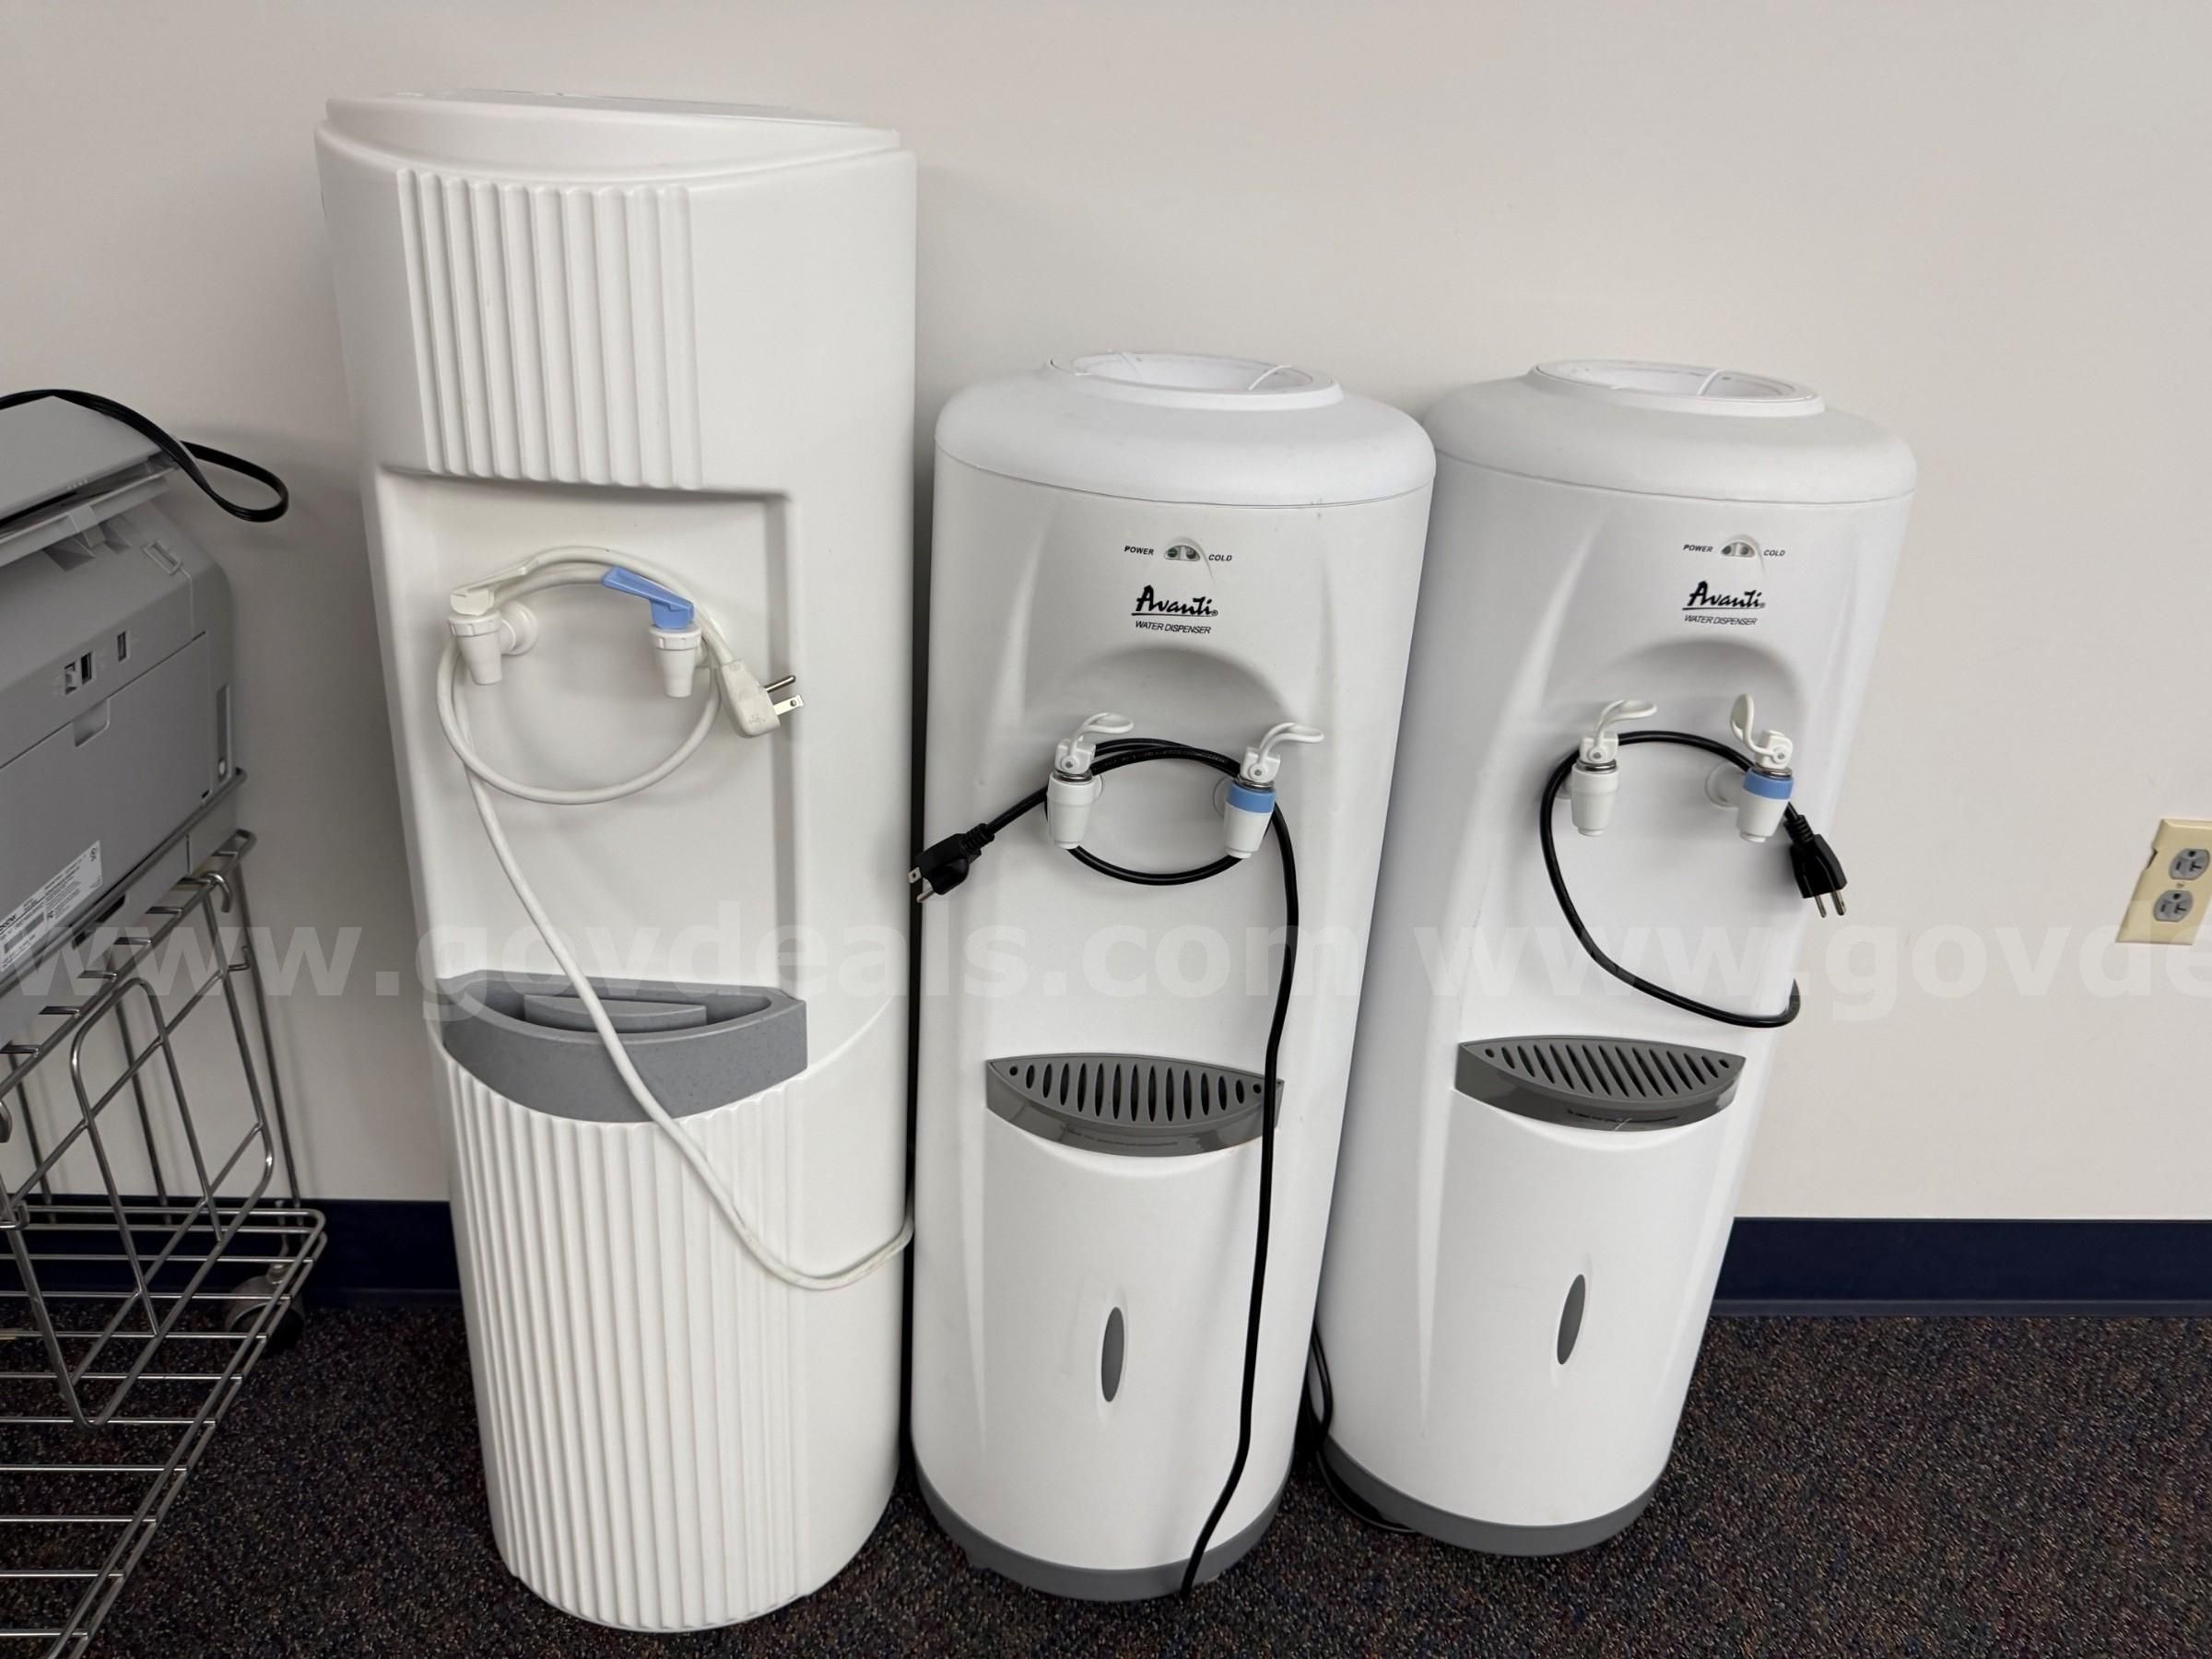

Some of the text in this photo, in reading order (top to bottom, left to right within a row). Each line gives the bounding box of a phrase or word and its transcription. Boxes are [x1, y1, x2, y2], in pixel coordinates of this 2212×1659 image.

[1124, 546, 1154, 555] POWER
[1684, 615, 1757, 625] WATER DISPENSER
[1135, 620, 1211, 634] WATER DISPENSER
